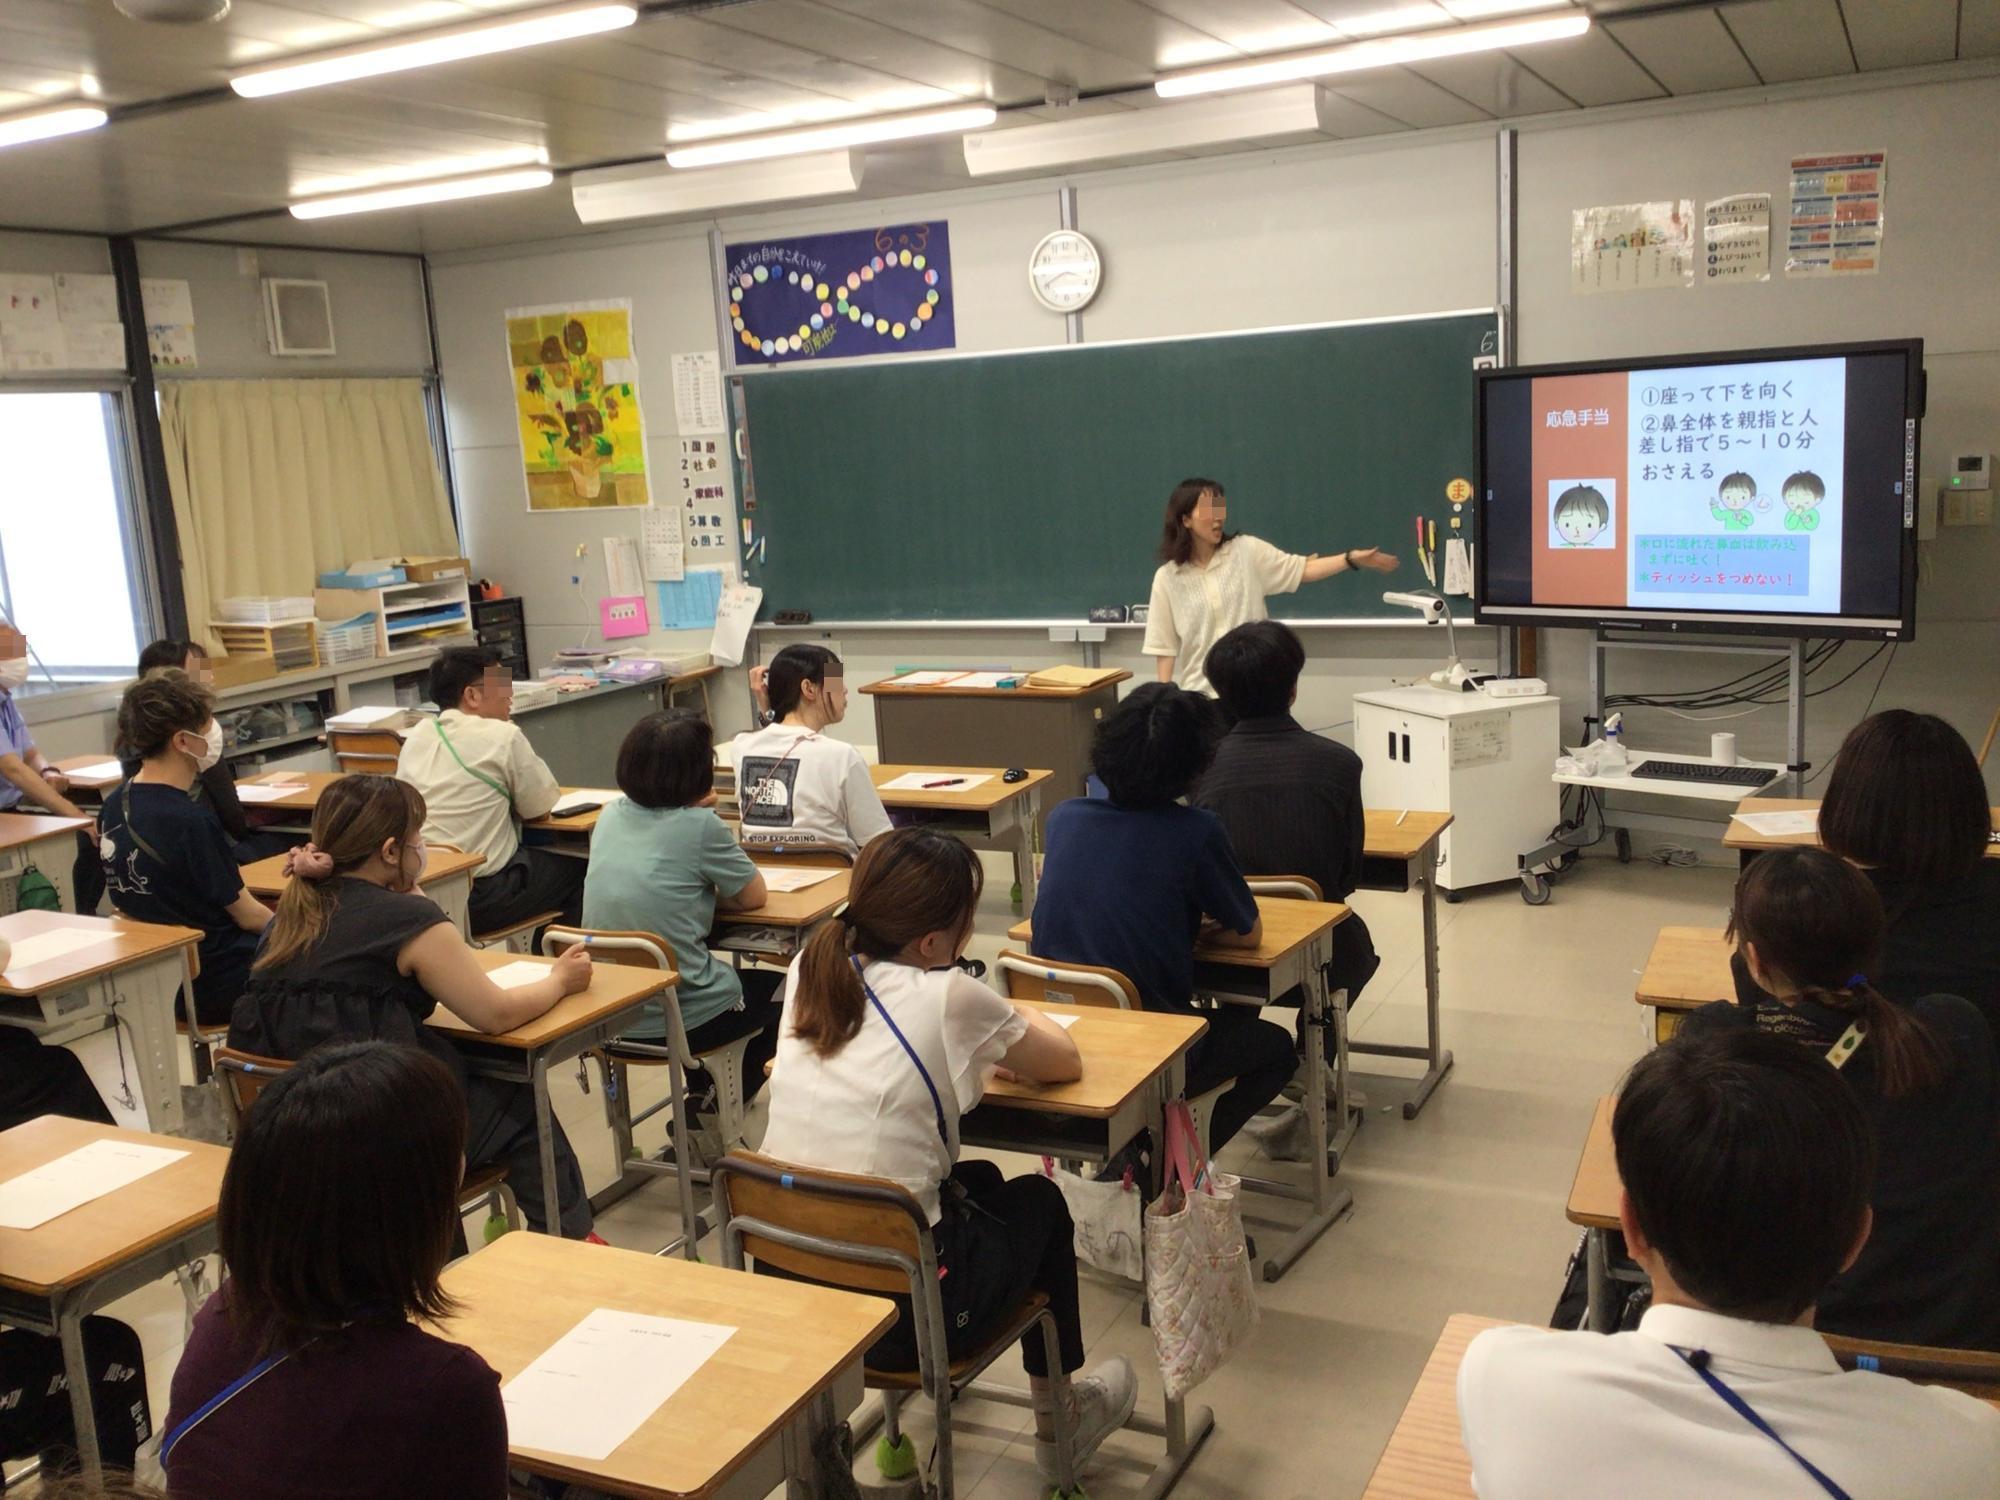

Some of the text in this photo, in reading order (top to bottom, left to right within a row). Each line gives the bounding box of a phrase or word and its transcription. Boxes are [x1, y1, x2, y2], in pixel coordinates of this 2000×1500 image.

[1641, 380, 1793, 406] ①座って下を向く
[1546, 408, 1609, 428] 応急手当
[1641, 408, 1819, 434] ②鼻全体を親指と人
[692, 441, 715, 453] 国語
[681, 457, 717, 472] 2 社会
[1642, 462, 1714, 480] おさえる
[683, 477, 690, 489] 3
[695, 486, 724, 499] 家庭科
[686, 498, 693, 508] 4
[689, 515, 721, 527] 5 算数
[691, 535, 725, 547] 6 図工
[755, 796, 773, 805] ACE
[749, 834, 767, 842] STOP
[770, 834, 816, 842] EXPLORING
